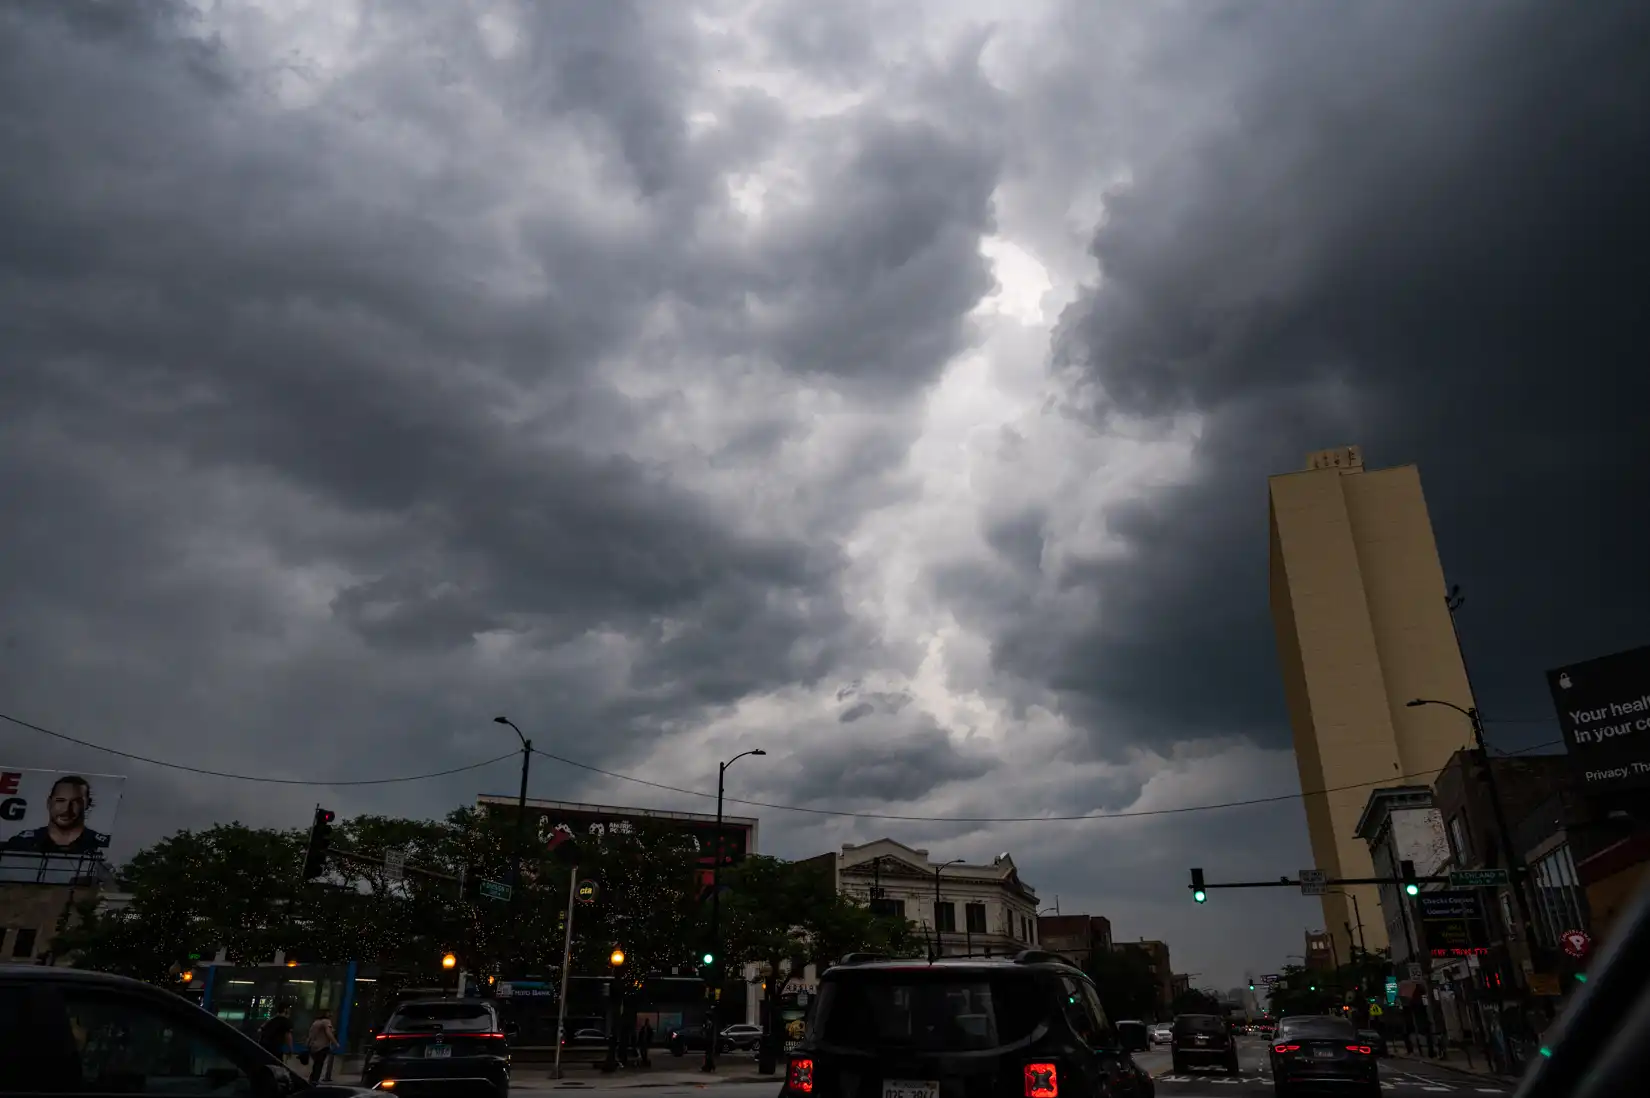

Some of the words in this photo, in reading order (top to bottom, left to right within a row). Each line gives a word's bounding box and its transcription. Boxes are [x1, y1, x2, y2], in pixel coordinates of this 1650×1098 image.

[1569, 707, 1608, 725] Your
[1574, 729, 1592, 744] In
[1593, 721, 1632, 743] your
[1585, 767, 1631, 782] Privacy.
[579, 886, 593, 895] cta
